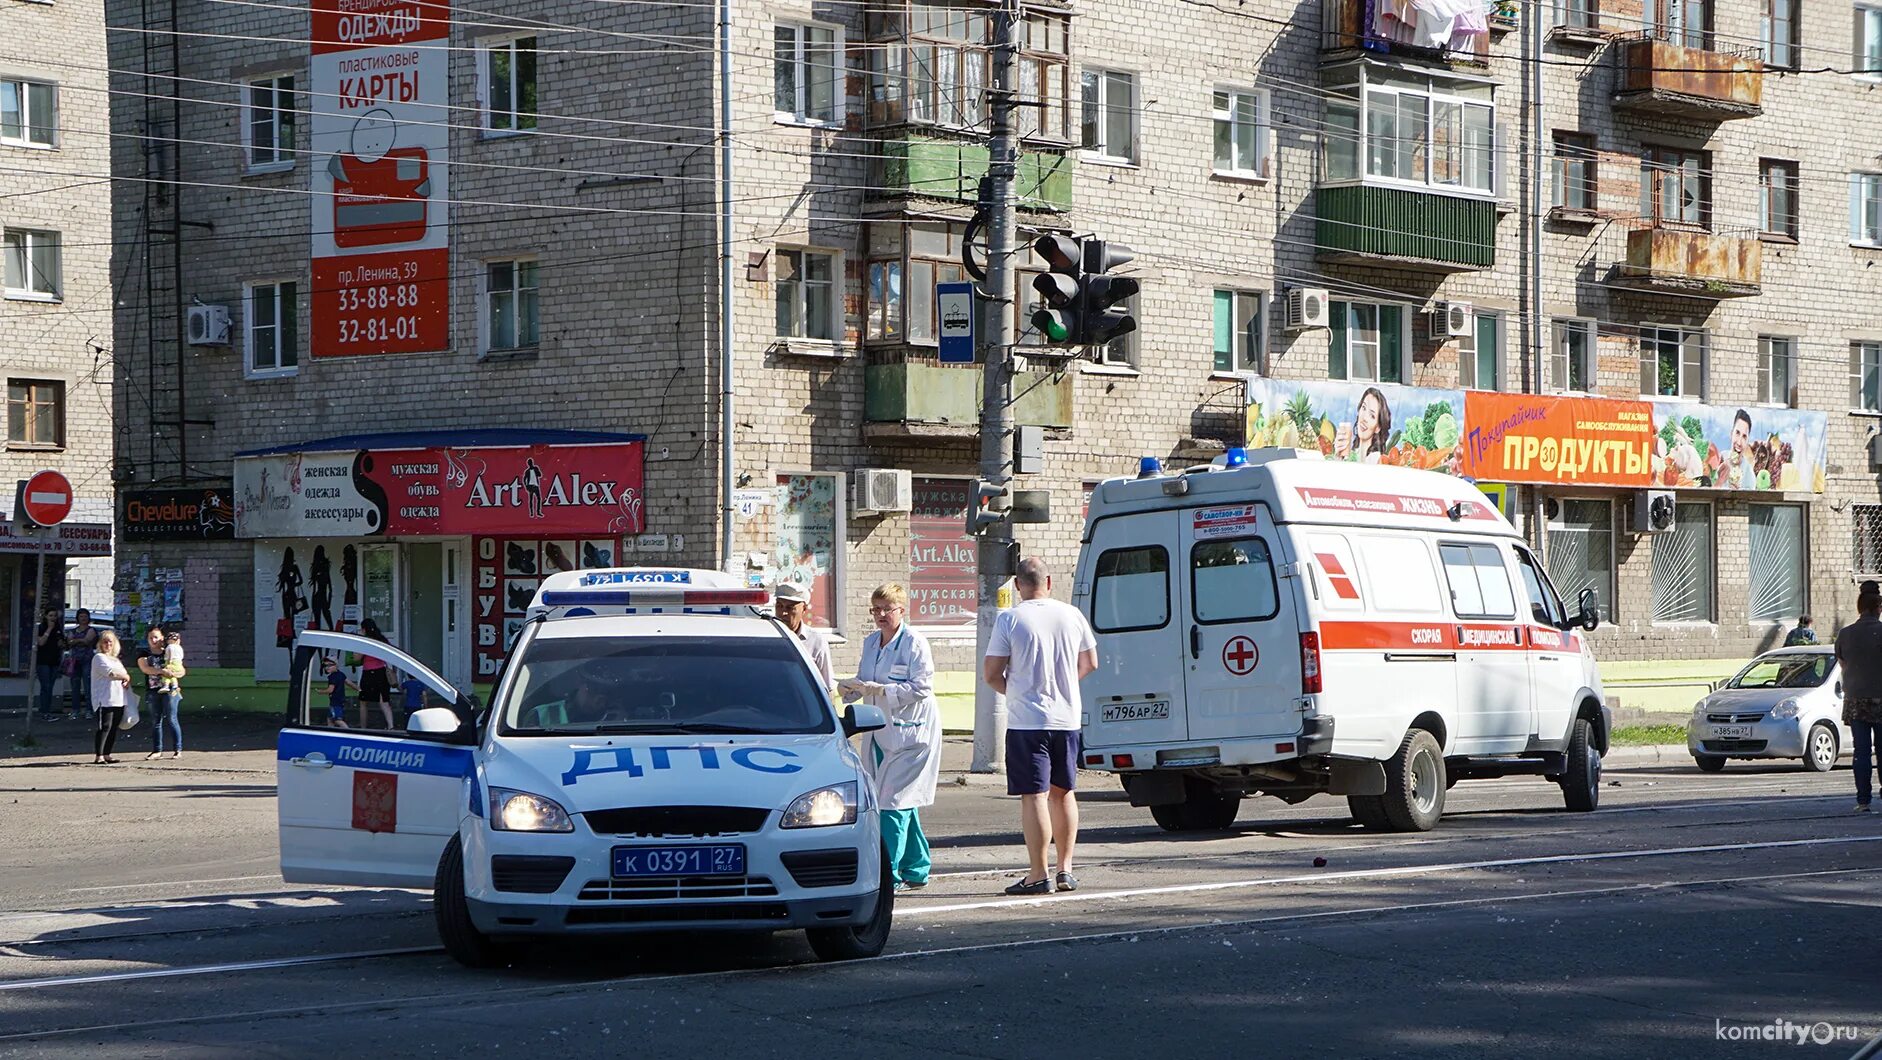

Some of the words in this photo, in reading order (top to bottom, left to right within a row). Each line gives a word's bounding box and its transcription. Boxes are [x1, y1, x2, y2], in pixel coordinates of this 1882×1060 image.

[338, 7, 420, 43] ОДЕЖДЫ
[339, 51, 419, 74] пластиковые
[339, 70, 419, 109] КАРТЫ
[404, 261, 418, 279] 39
[338, 284, 418, 311] 33-88-88
[338, 316, 418, 343] 32-81-01
[1618, 412, 1649, 422] МАГАЗИН
[1576, 421, 1649, 432] САМООБСЛУЖИВАНИЯ
[1469, 405, 1547, 468] Покупайчик
[1503, 435, 1649, 479] ПРОДУКТЫ
[304, 465, 348, 478] женская
[391, 463, 439, 479] мужская
[304, 487, 341, 499] одежда
[408, 482, 440, 499] обувь
[465, 474, 523, 507] Art
[543, 473, 618, 506] Alex
[912, 491, 966, 505] мужска
[127, 500, 198, 522] Chevelure
[304, 507, 364, 522] аксессуары
[400, 506, 440, 519] одежда
[742, 502, 752, 514] 41
[1398, 496, 1443, 515] ЖИЗНЬ
[59, 526, 112, 540] КСЕССУАРЫ
[127, 524, 198, 532] COLLECTIONS
[911, 543, 976, 563] Art.Alex
[910, 588, 976, 603] мужская
[919, 600, 966, 618] обувь
[1411, 628, 1442, 644] СКОРАЯ
[1463, 629, 1515, 647] МЕДИЦИНСКАЯ
[337, 745, 426, 768] ПОЛИЦИЯ
[561, 746, 803, 786] ДПС
[647, 850, 700, 872] 0391
[714, 848, 735, 865] 27
